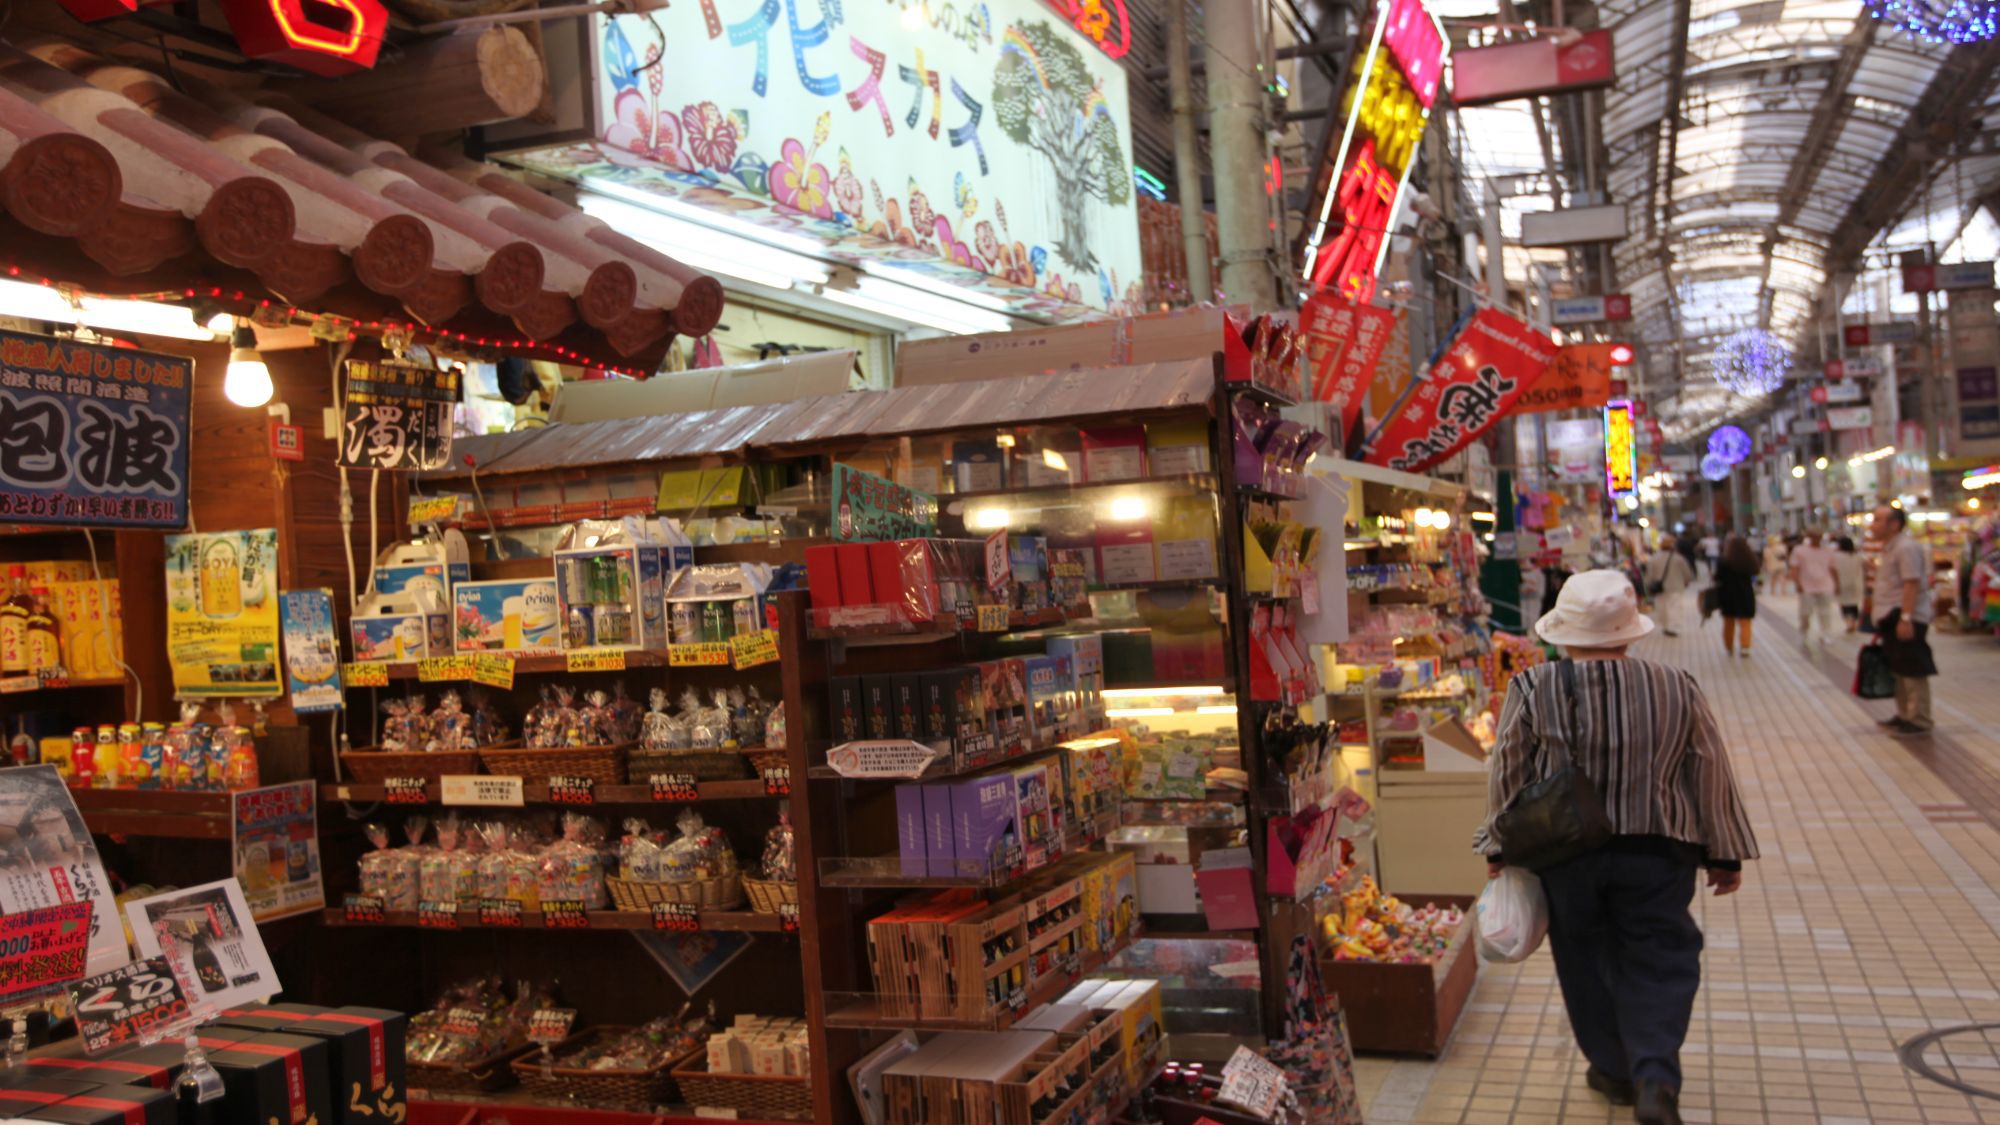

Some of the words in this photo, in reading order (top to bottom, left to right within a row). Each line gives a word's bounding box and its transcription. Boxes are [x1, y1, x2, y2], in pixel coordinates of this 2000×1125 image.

[697, 0, 990, 176] イビスカス
[202, 557, 238, 569] GOYA
[342, 663, 386, 674] リオンビール
